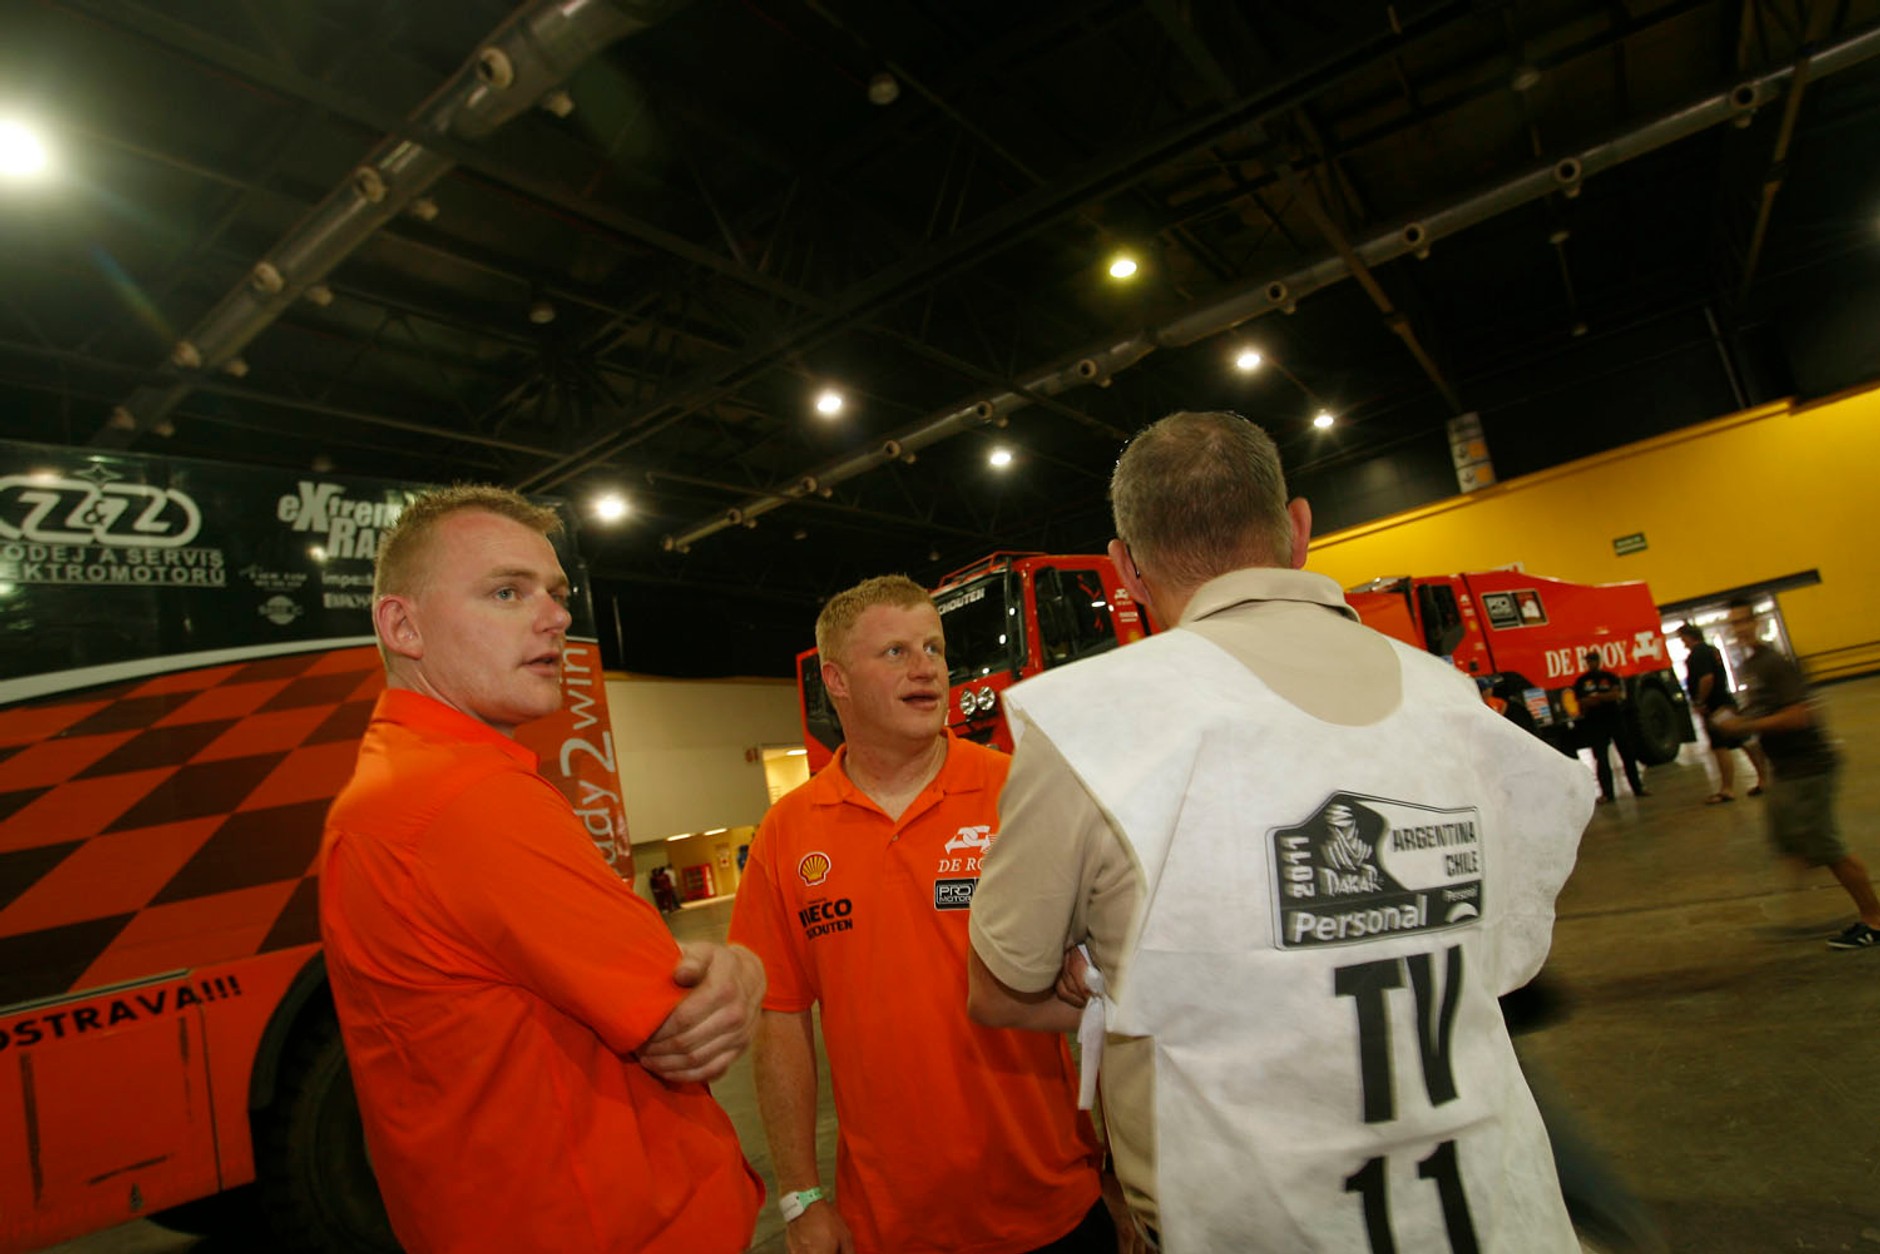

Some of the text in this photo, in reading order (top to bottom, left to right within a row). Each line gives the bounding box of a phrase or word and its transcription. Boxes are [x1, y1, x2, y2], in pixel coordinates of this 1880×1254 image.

[100, 548, 118, 564] A
[126, 548, 224, 568] SERVIS
[1545, 648, 1575, 678] DE
[1392, 821, 1477, 852] ARGENTINA
[937, 858, 962, 873] DE
[1281, 836, 1316, 898] 2011
[1445, 851, 1478, 877] CHILE
[1289, 893, 1428, 943] Personal
[1335, 944, 1462, 1124] TV
[1343, 1140, 1482, 1254] 11
